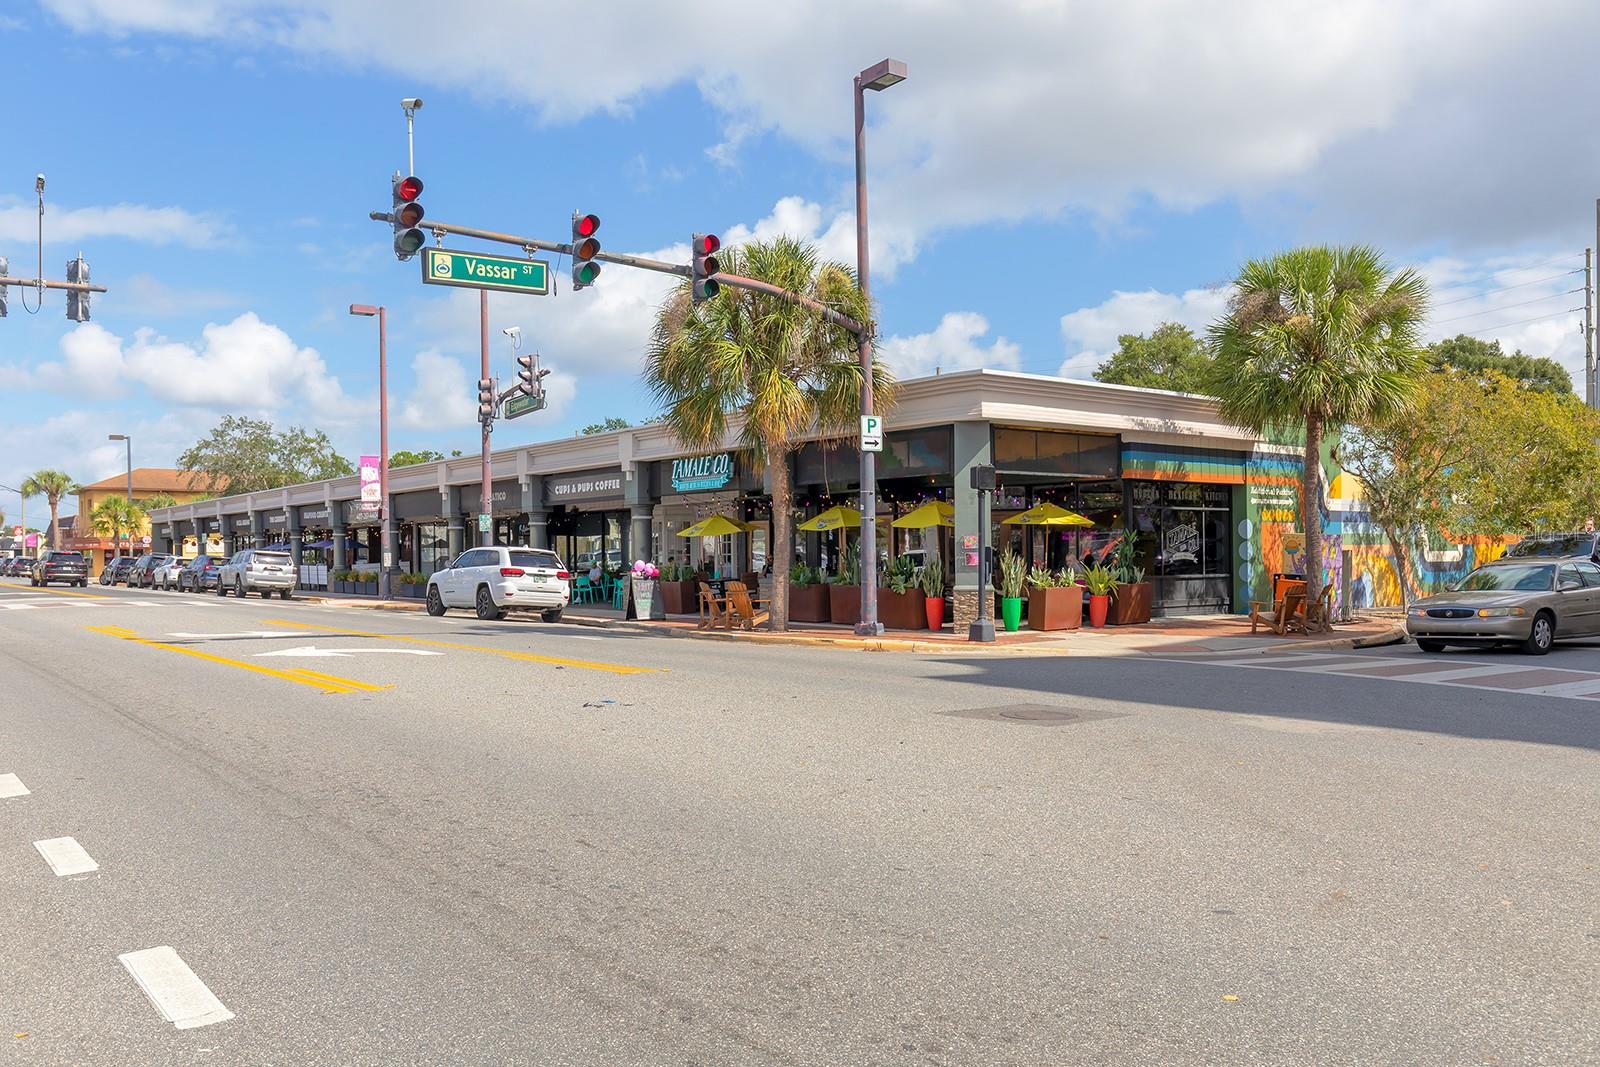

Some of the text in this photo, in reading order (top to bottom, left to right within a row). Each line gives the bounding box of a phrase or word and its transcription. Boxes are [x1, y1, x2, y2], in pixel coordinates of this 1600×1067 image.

[464, 258, 533, 280] Vassar ST
[867, 418, 877, 434] P
[672, 454, 729, 479] TAMALE CO.
[554, 479, 620, 495] CUPS & PUPS COFFEE
